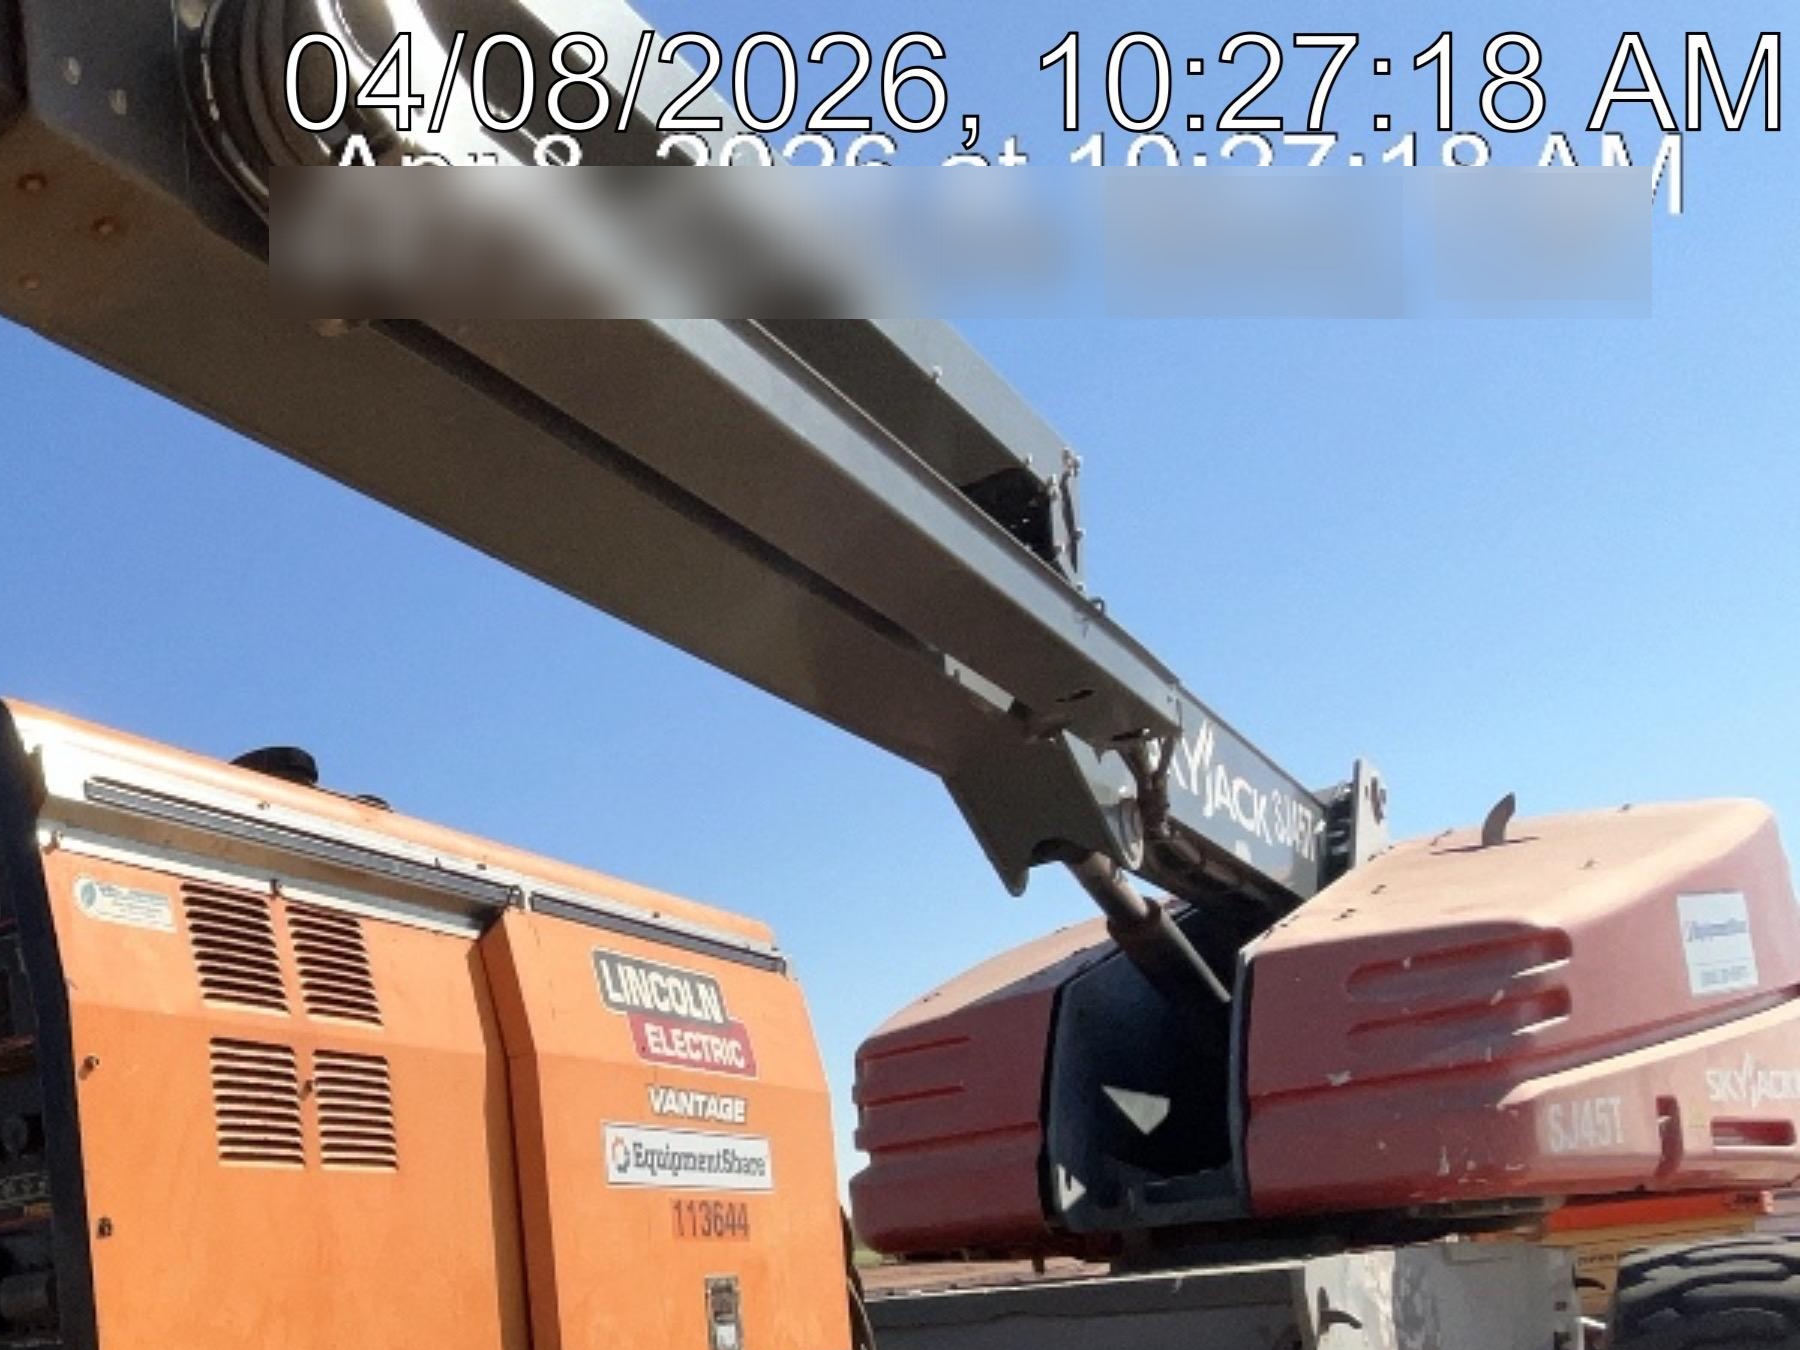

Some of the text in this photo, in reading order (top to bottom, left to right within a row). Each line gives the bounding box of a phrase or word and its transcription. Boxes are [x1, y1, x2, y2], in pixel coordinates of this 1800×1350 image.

[599, 959, 725, 1025] LINCOLN
[643, 1022, 746, 1069] ELECTRIC
[648, 1086, 747, 1124] VANTAGE
[1550, 1096, 1624, 1154] SJ45T
[632, 1142, 767, 1178] EquipmentShare
[672, 1199, 749, 1238] 113644
